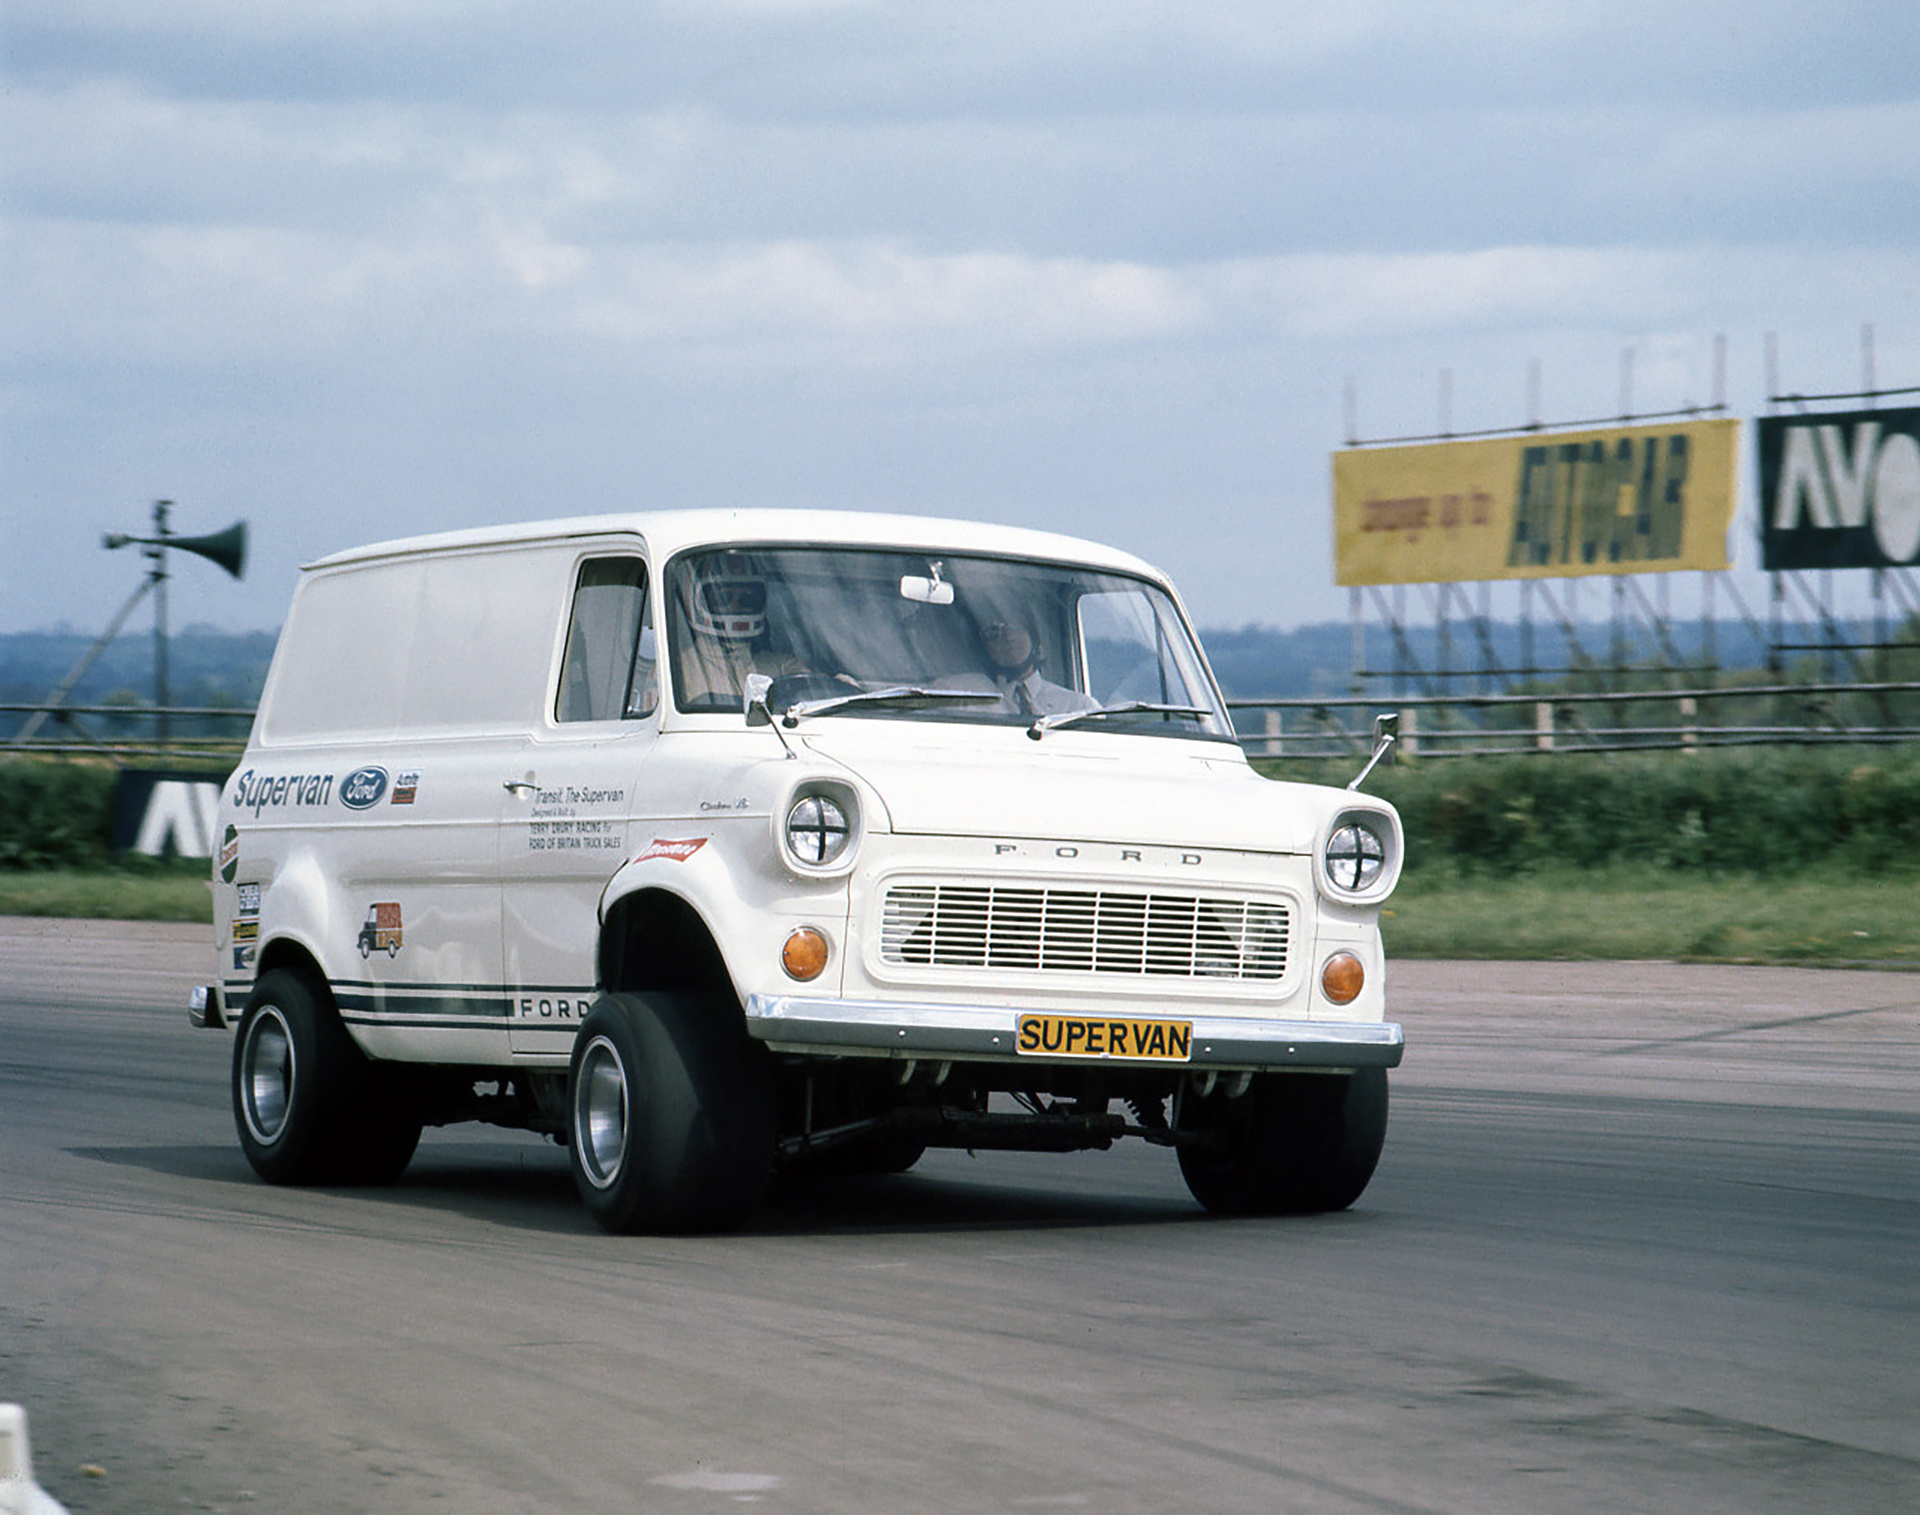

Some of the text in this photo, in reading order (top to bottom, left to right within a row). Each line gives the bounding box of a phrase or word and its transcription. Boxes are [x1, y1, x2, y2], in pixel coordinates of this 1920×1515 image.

[234, 768, 334, 819] Supervan
[563, 786, 580, 804] The
[580, 785, 624, 806] Supervan
[529, 821, 549, 834] TERRY
[551, 821, 574, 834] DRURY
[576, 821, 602, 833] RACING
[529, 835, 621, 850] FORD OF BRITAIN TRUCK SALES
[994, 844, 1202, 867] FORD
[520, 998, 591, 1019] FORD
[1019, 1017, 1191, 1057] SUPERVAN
